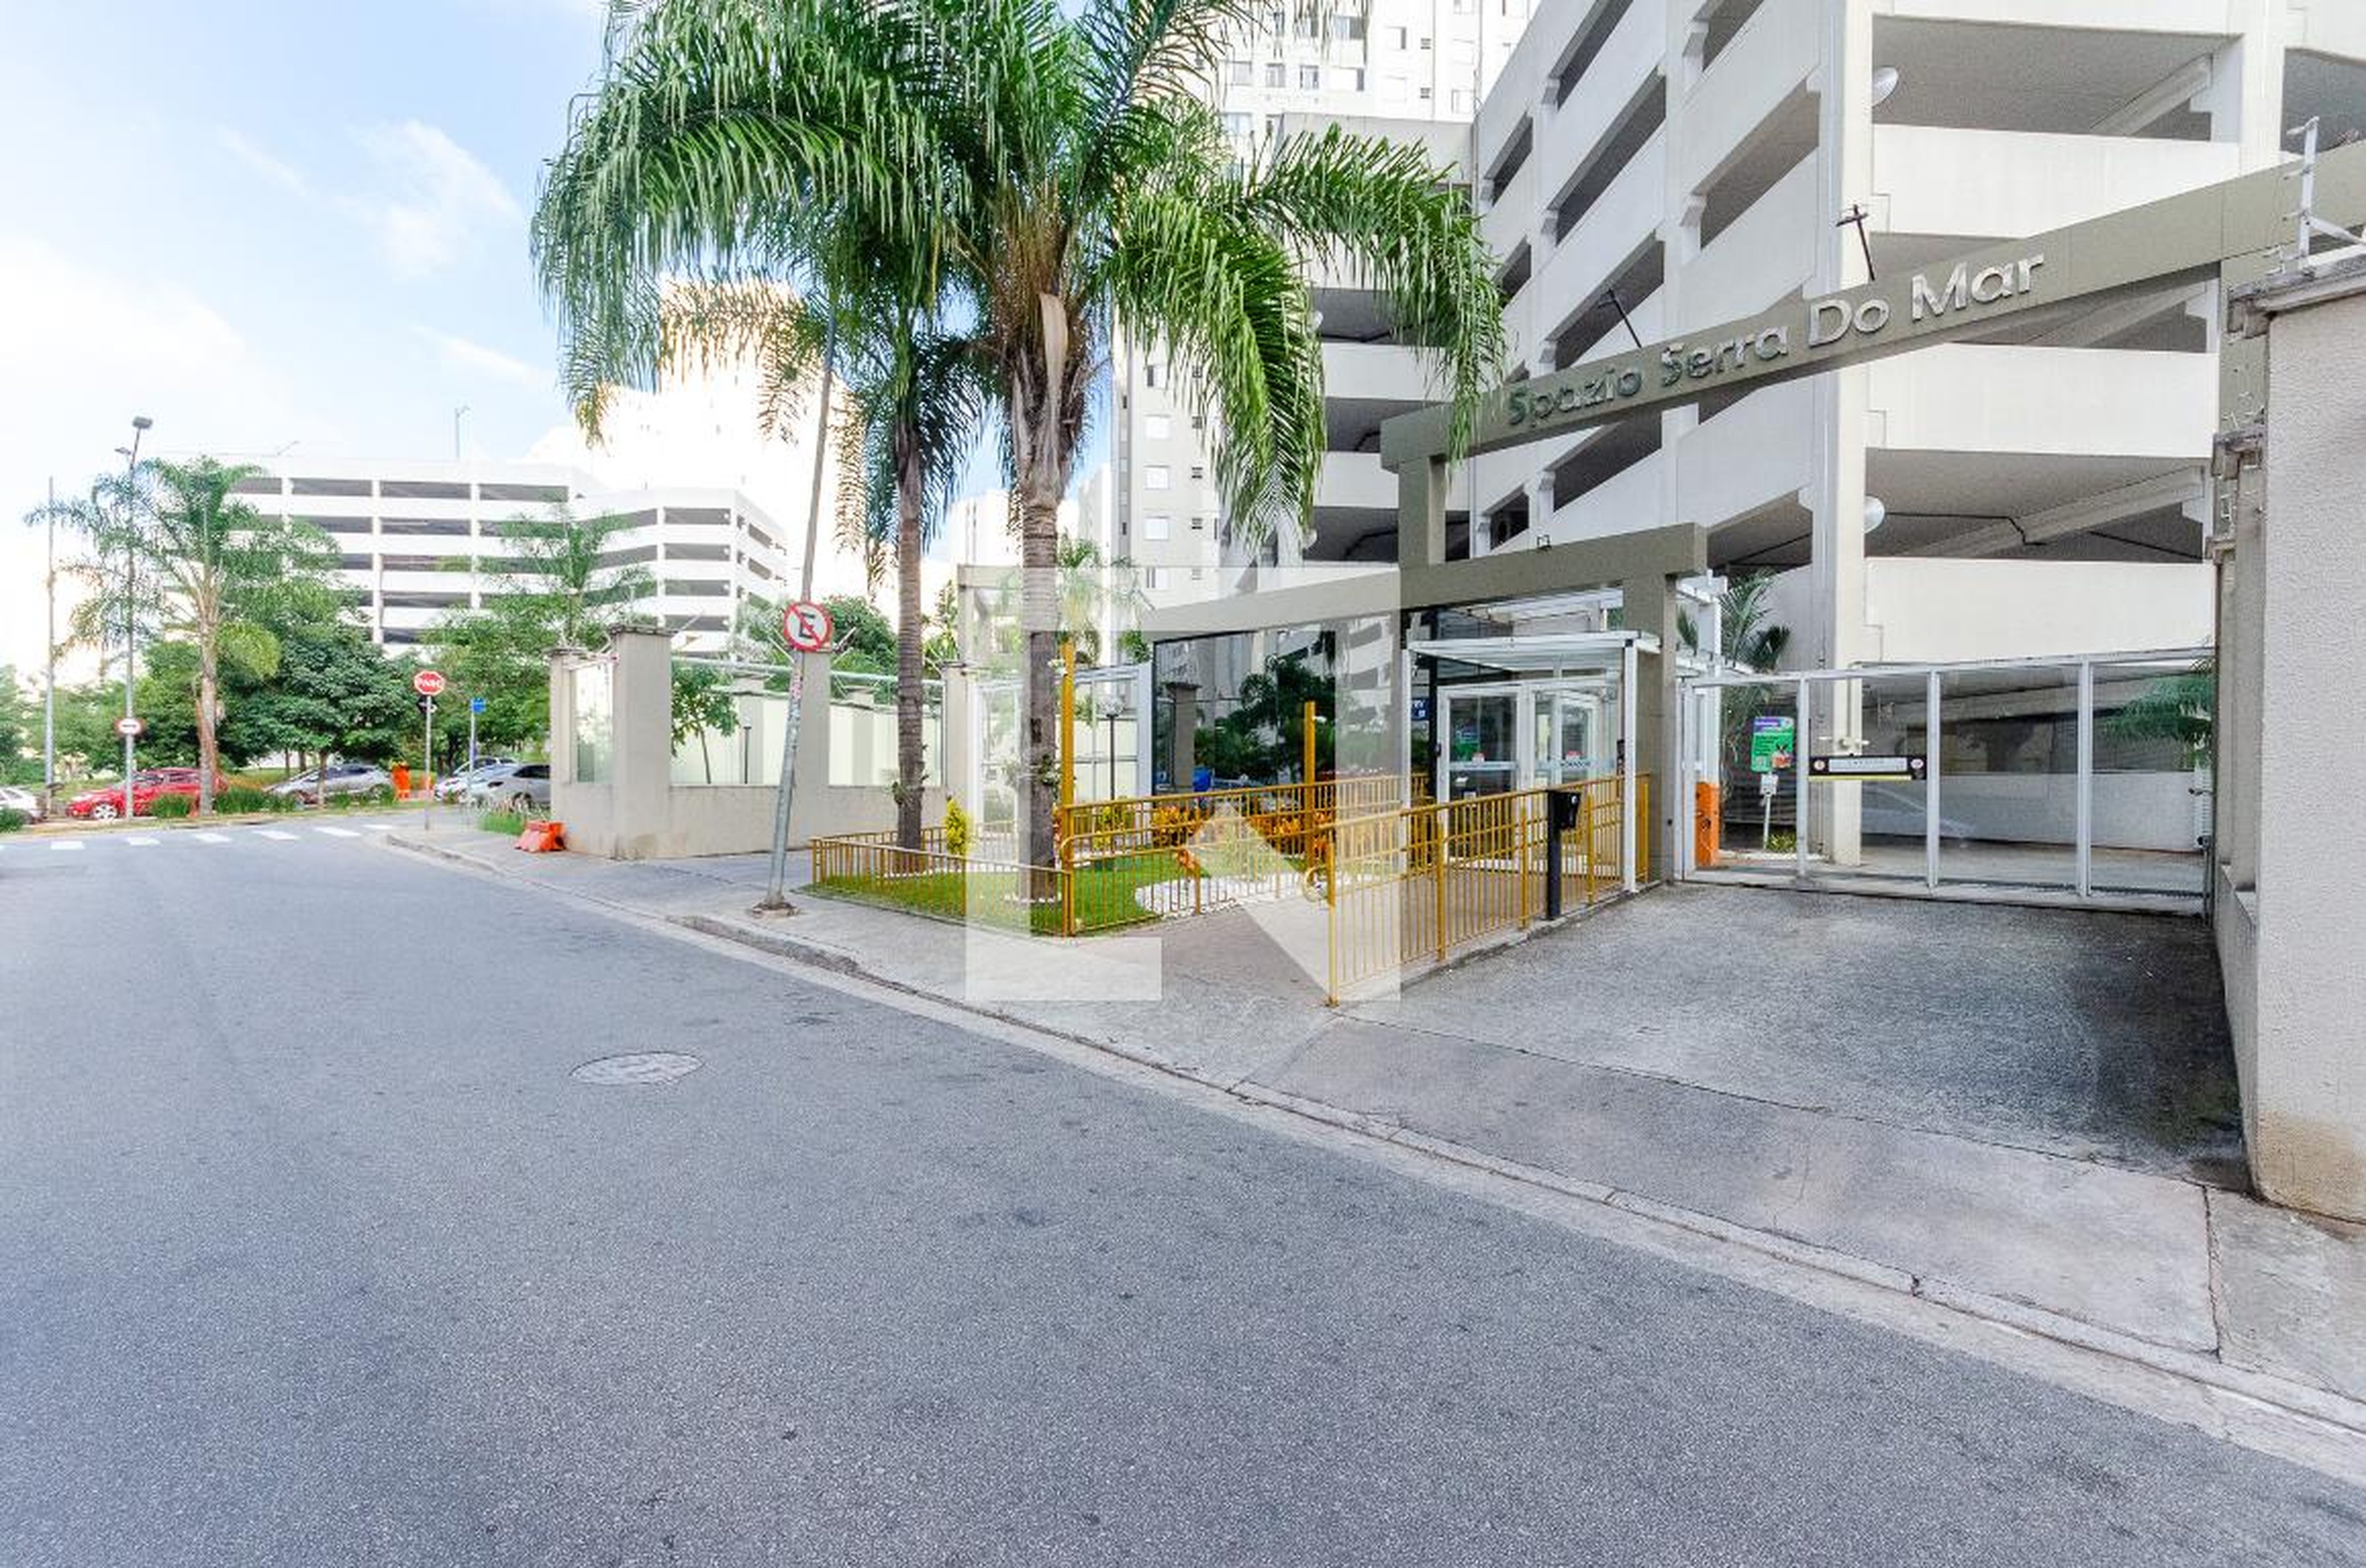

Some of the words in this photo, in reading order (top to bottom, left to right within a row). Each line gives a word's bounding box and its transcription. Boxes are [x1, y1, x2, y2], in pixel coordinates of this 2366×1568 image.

[1508, 368, 1642, 428] Spazio
[1662, 327, 1788, 388] Serra
[1809, 299, 1890, 349] Do
[1911, 253, 2044, 322] Mar
